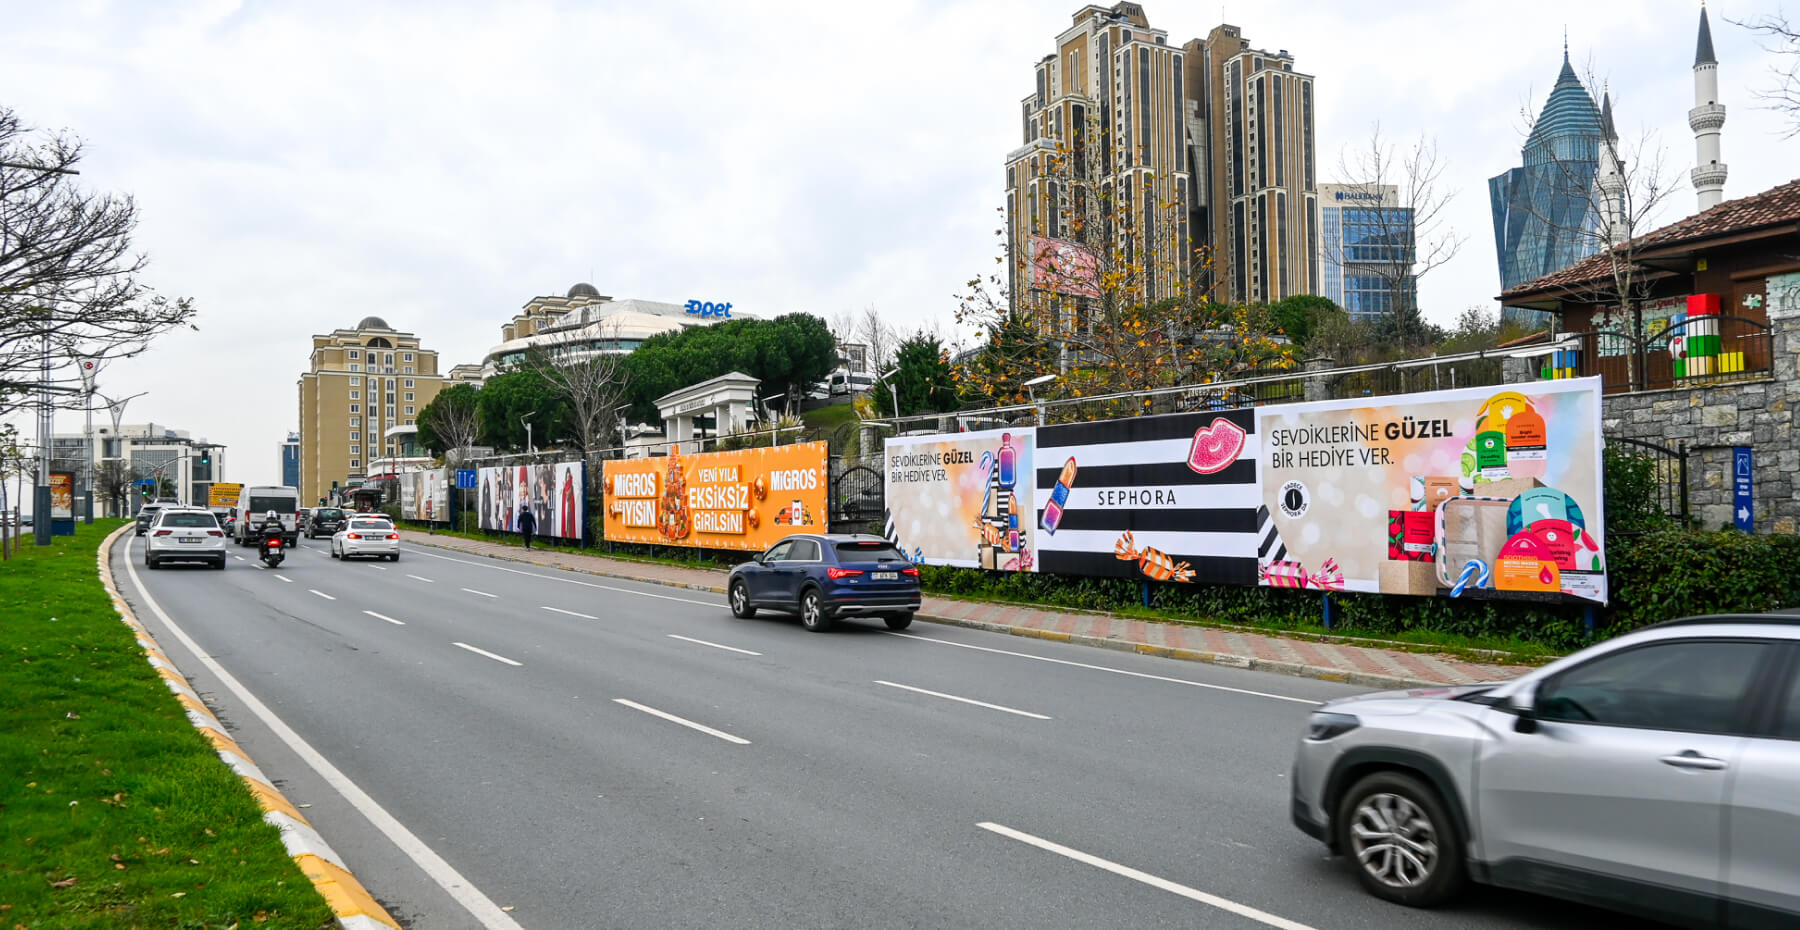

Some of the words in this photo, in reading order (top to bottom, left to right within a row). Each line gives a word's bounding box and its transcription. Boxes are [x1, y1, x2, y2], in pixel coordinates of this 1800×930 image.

[1272, 421, 1379, 446] SEVDİKLERİNE
[1385, 416, 1453, 440] GÜZEL
[891, 452, 941, 468] SEVDİKLERİNE
[943, 448, 974, 465] GÜZEL
[1272, 449, 1294, 468] BİR
[1299, 446, 1354, 467] HEDİYE
[1359, 448, 1394, 465] VER.
[698, 466, 717, 482] YENİ
[719, 467, 739, 482] YILA
[891, 469, 902, 483] BİR
[904, 467, 931, 482] HEDİYE
[931, 469, 948, 481] VER.
[690, 483, 749, 509] EKSİKSİZ
[1098, 489, 1176, 506] SEPHORA
[694, 511, 743, 532] GİRİLSİN!
